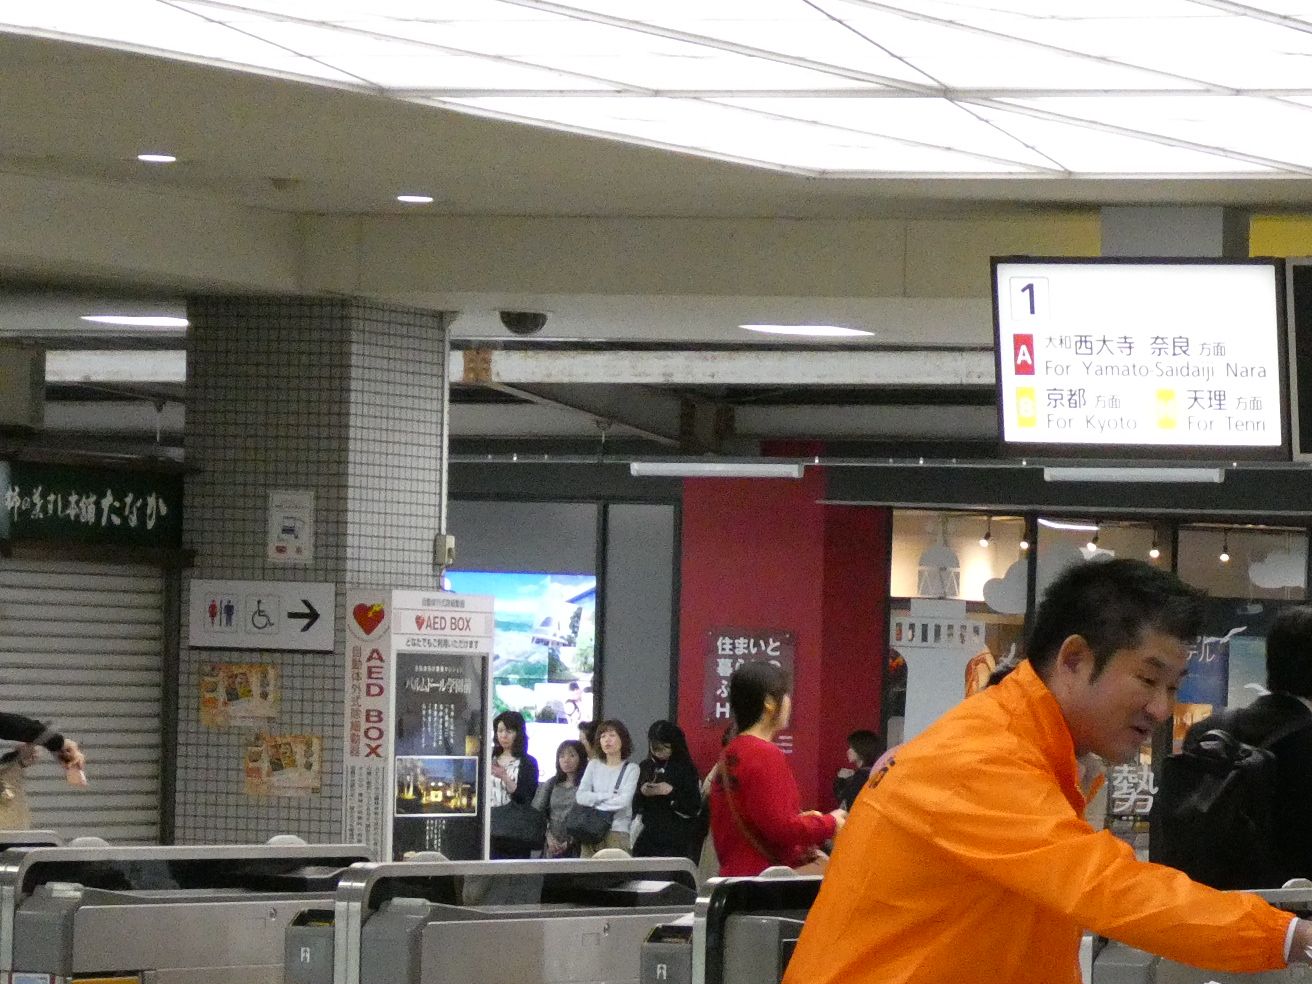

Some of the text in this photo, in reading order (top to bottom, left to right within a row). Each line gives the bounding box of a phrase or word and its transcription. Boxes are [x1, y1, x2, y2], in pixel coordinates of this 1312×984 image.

[1021, 283, 1035, 315] 1
[1016, 345, 1032, 364] A
[1150, 336, 1190, 357] 奈良
[1200, 342, 1226, 356] 方面
[1045, 361, 1071, 377] For
[1226, 362, 1267, 378] Nara
[1046, 388, 1121, 408] 京都 方面
[1187, 390, 1262, 411] 天理 方面
[1046, 414, 1138, 433] For Kyoto
[1188, 416, 1266, 431] For Tenri
[425, 616, 472, 631] AED BOX
[716, 636, 781, 656] 住まいと
[366, 648, 385, 698] AED
[365, 709, 385, 758] BOX
